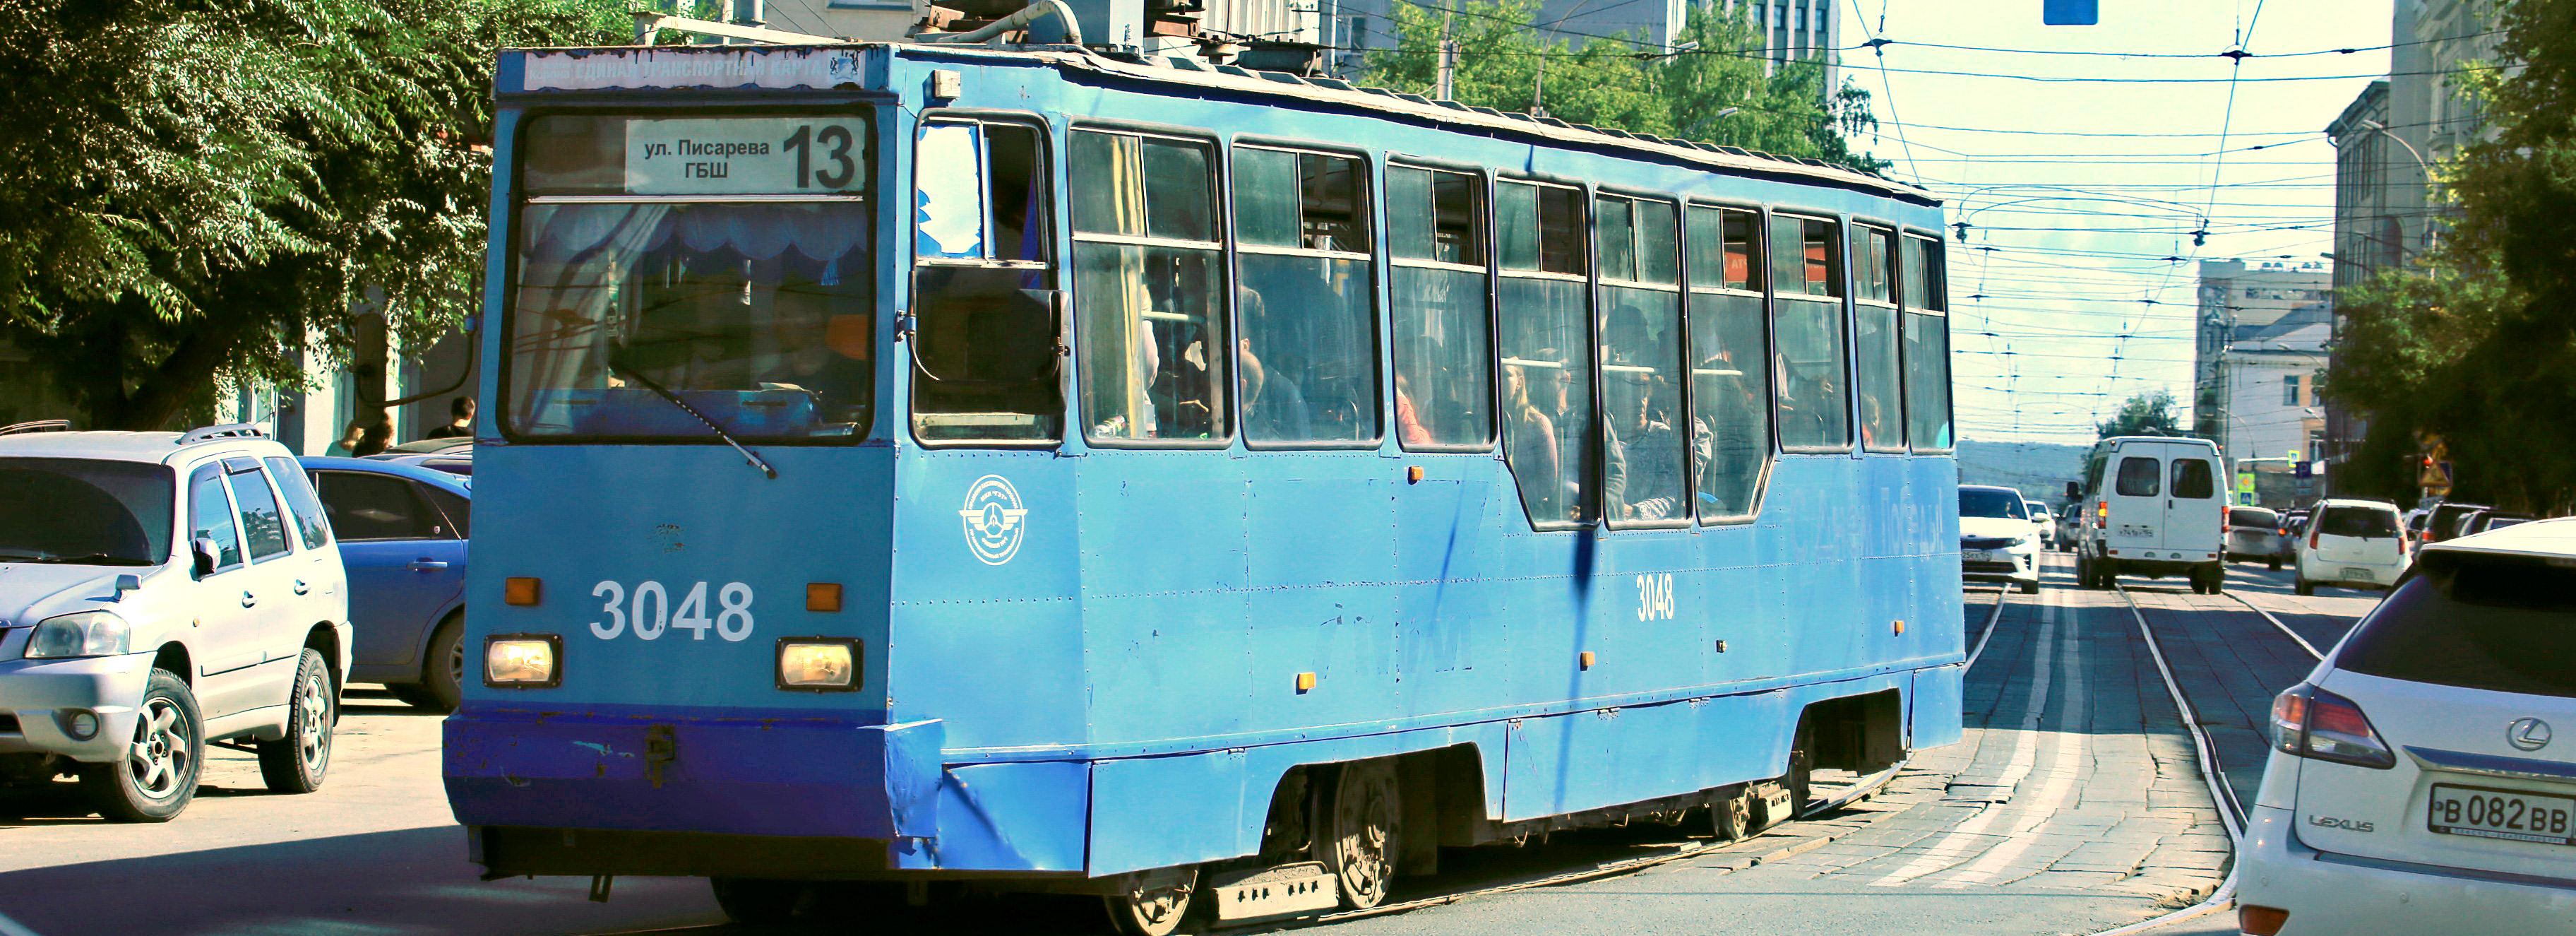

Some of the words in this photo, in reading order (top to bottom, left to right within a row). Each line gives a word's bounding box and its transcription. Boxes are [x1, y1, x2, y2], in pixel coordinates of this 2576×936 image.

[576, 61, 638, 81] ЕДИНАЯ
[642, 59, 765, 79] ТРАНСПОРТНАЯ
[770, 59, 822, 76] КАРТА
[644, 142, 672, 159] ул.
[679, 139, 770, 159] Писарева
[782, 125, 855, 189] 13
[684, 162, 728, 179] ГБШ
[1636, 573, 1674, 622] 3048
[590, 580, 754, 641] 3048
[2308, 814, 2374, 833] LEXUS
